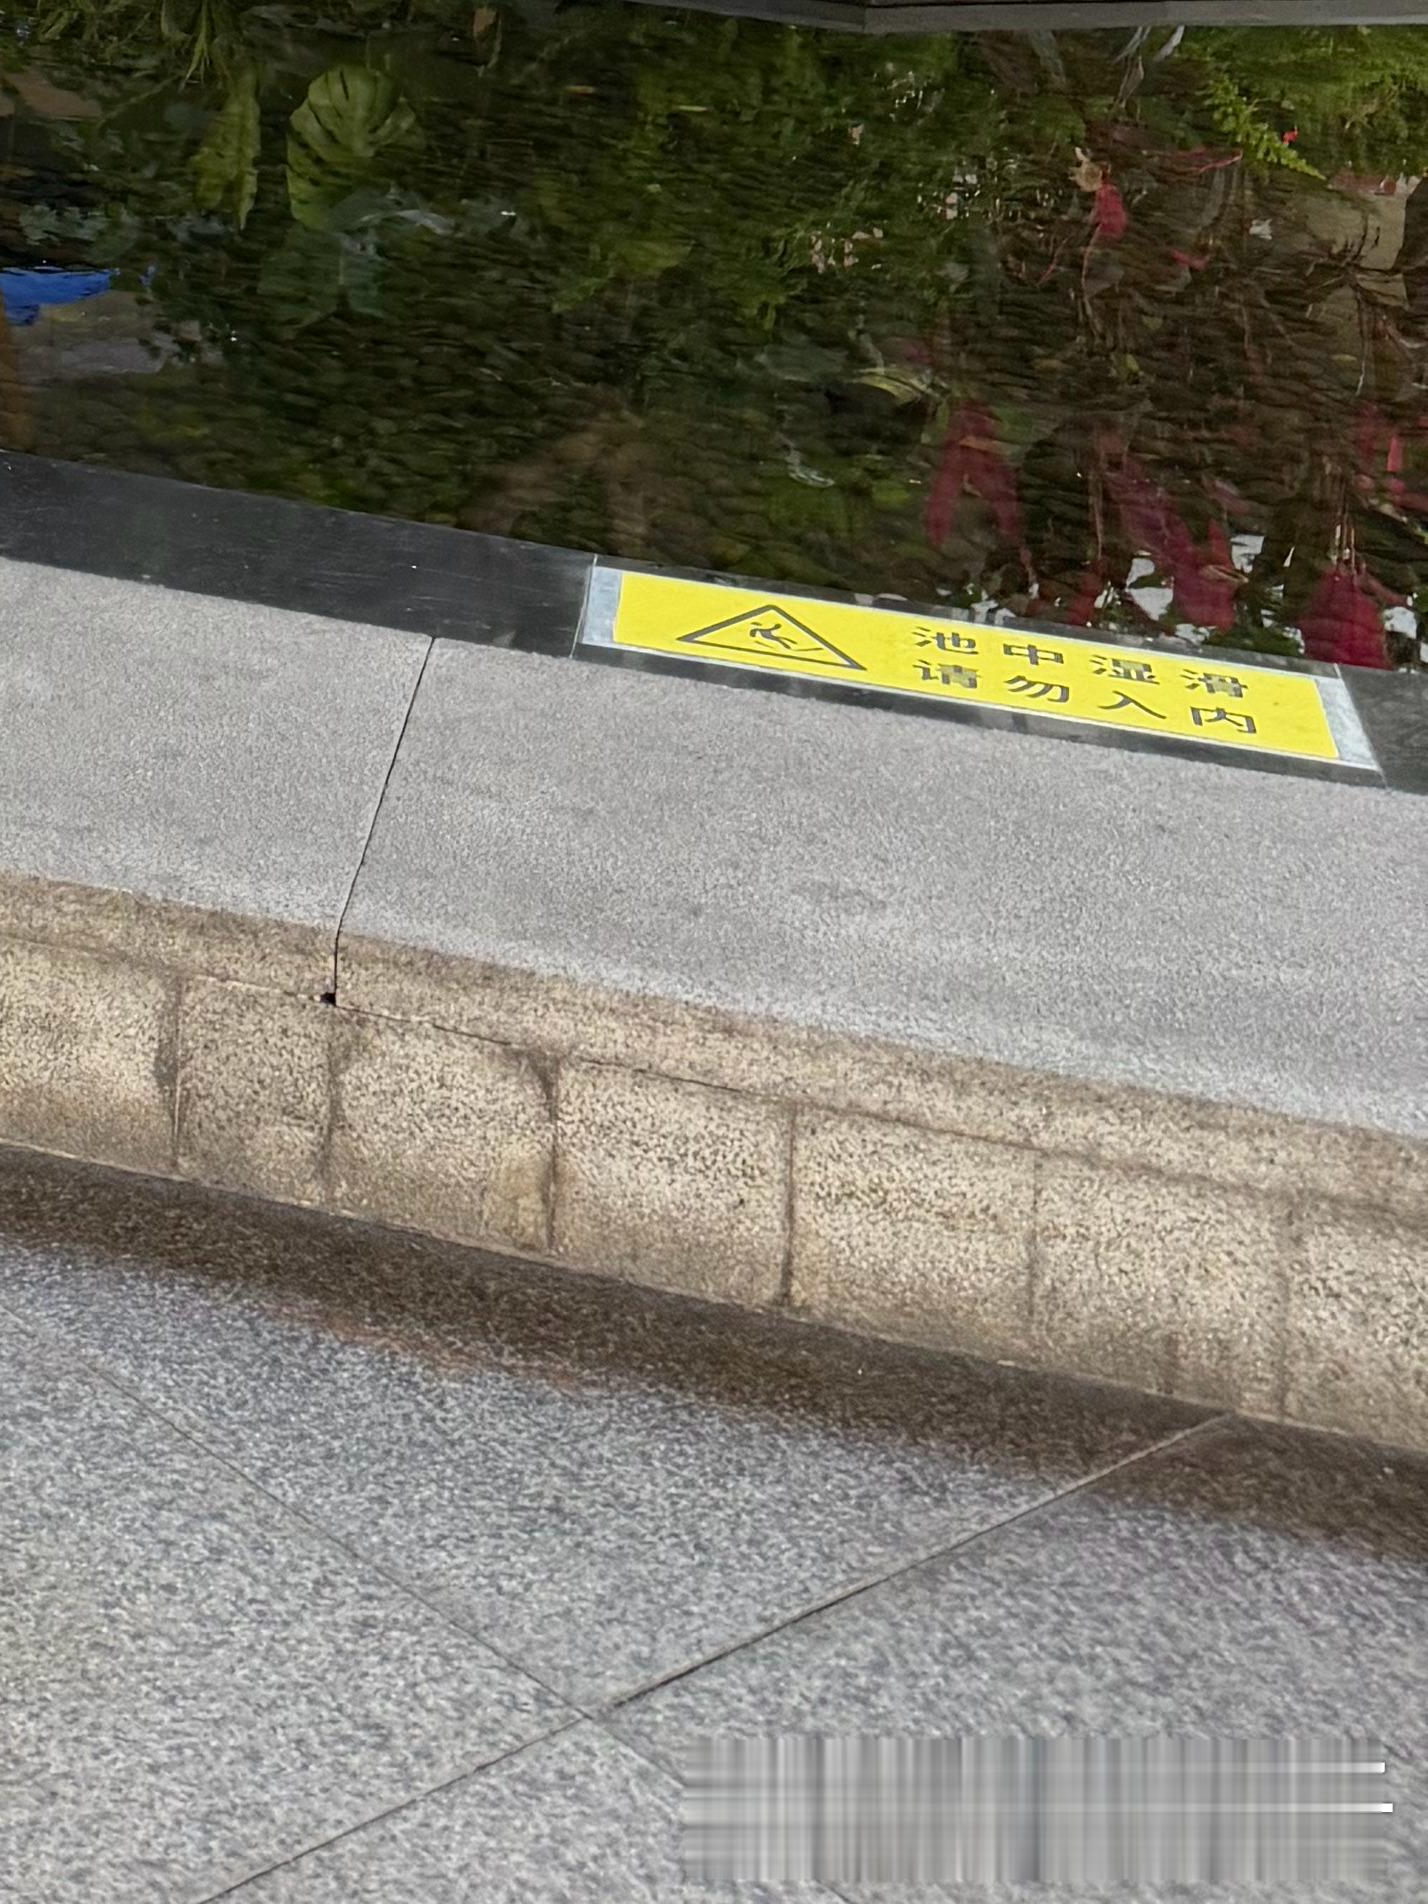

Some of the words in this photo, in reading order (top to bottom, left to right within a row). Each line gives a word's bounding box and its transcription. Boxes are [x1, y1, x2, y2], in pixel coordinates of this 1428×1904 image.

[911, 625, 1249, 699] 池中湿滑
[911, 658, 1258, 735] 请勿入内
